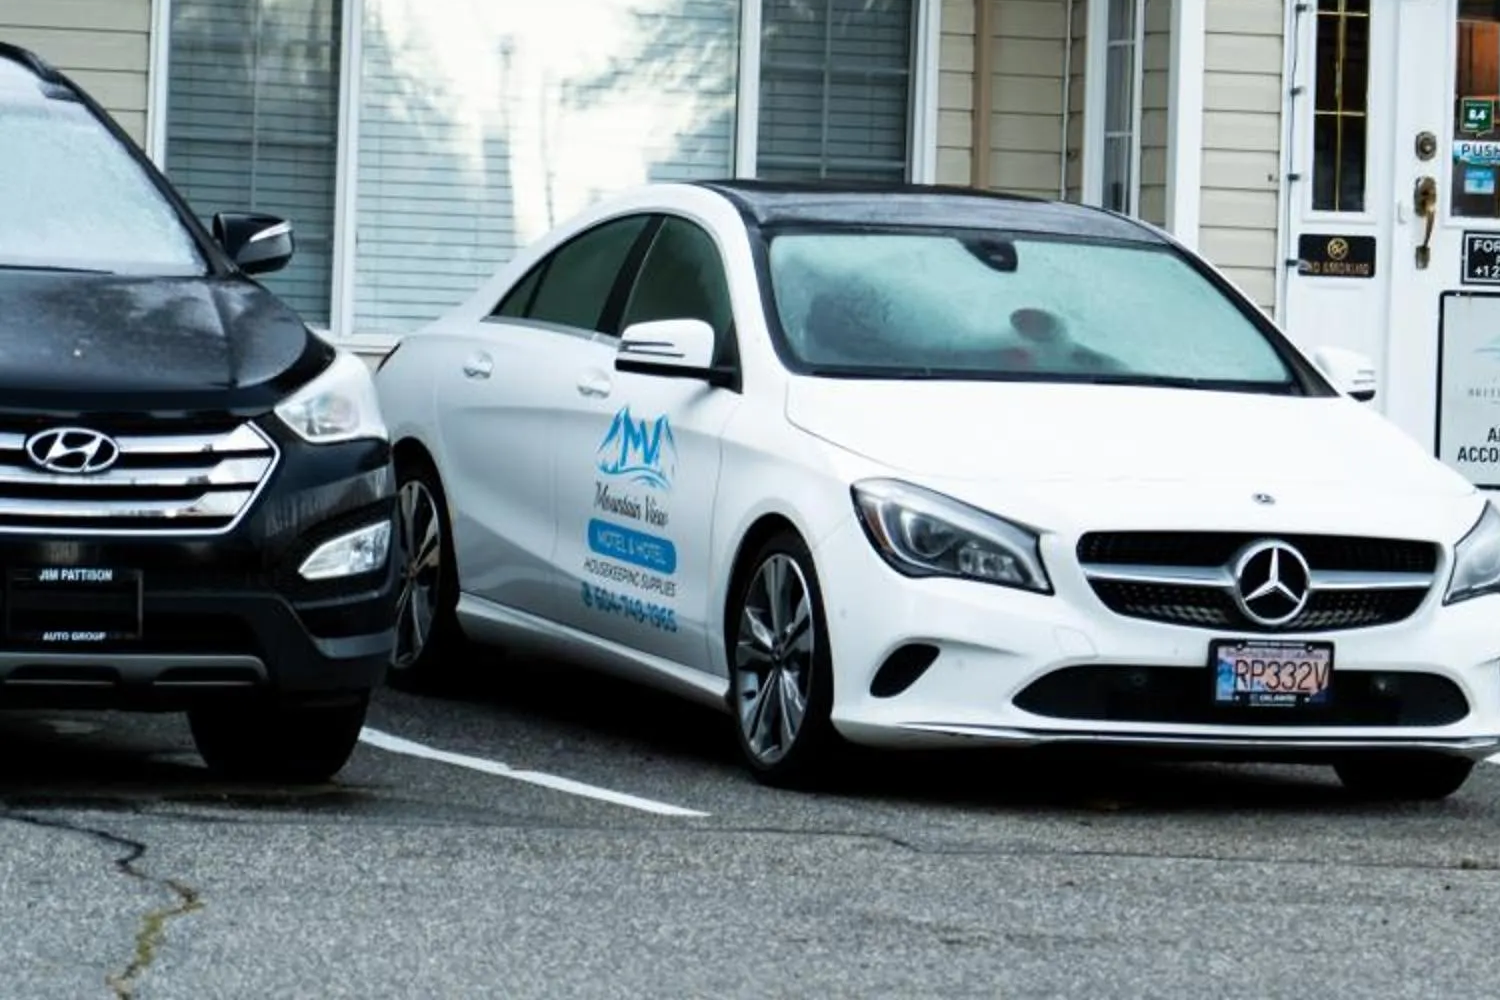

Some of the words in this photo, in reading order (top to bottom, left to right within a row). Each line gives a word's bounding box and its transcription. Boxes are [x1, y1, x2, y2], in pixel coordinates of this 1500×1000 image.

[39, 568, 59, 581] JIM
[61, 568, 113, 581] PATTISON
[43, 632, 70, 641] AUTO
[71, 632, 106, 641] GROUP
